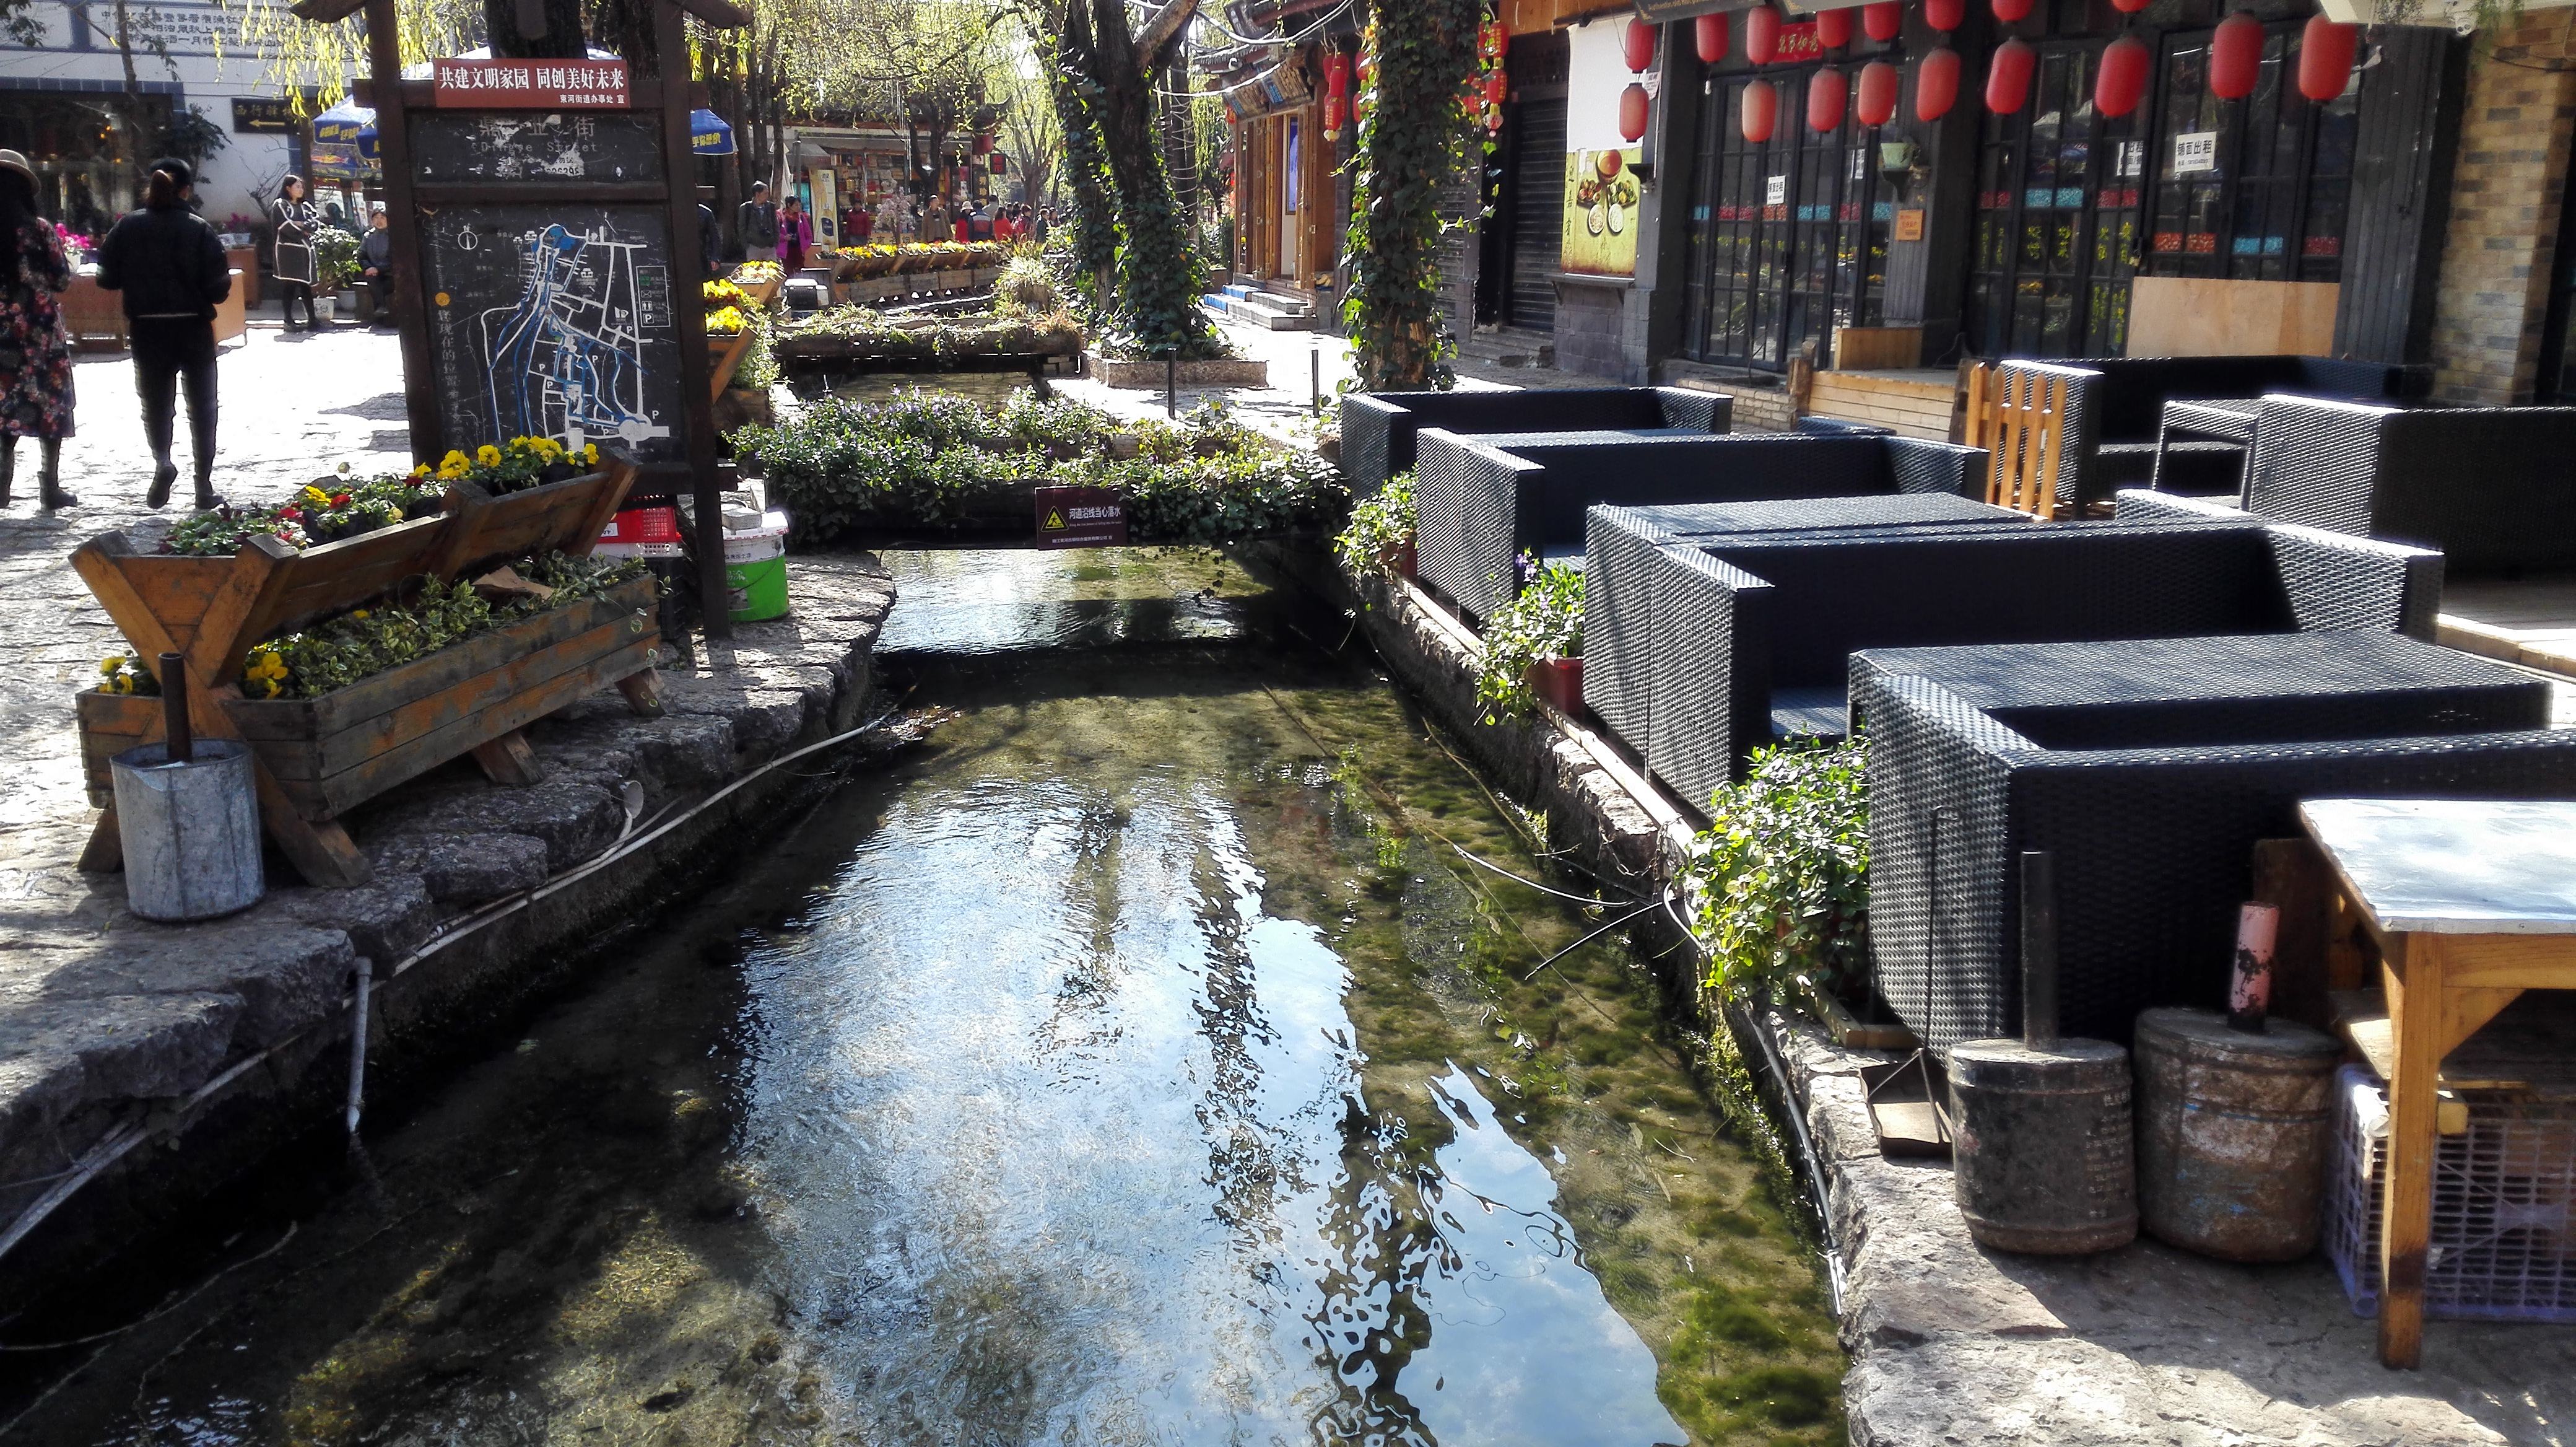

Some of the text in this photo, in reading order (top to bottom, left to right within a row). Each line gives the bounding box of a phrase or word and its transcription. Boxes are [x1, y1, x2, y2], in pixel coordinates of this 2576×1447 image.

[439, 67, 624, 90] 共建文明家园 同创美好未来
[617, 95, 624, 103] 宣
[1069, 506, 1121, 519] 河道沿线当心落水
